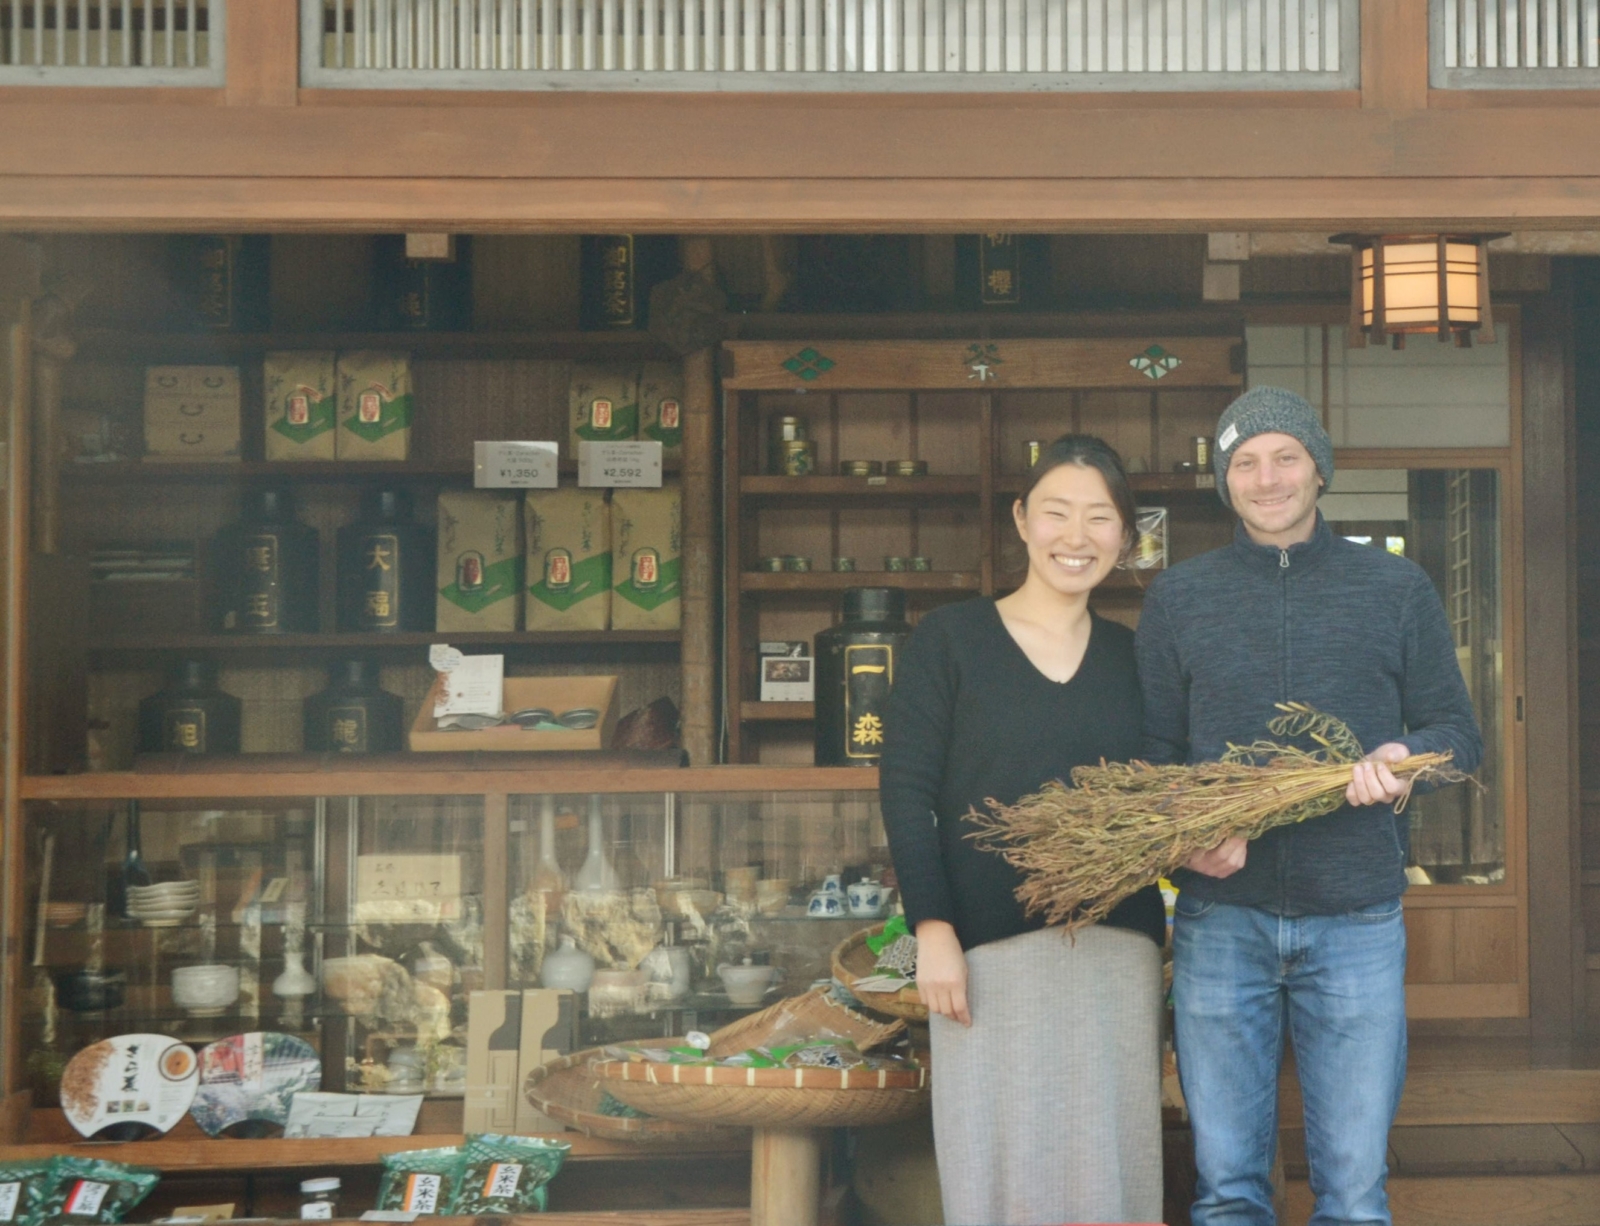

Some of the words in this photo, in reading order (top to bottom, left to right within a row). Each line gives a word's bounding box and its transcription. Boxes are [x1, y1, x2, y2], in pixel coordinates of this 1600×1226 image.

[499, 468, 539, 478] ¥1,350
[603, 468, 642, 477] ¥2,592
[366, 544, 391, 617] 大福
[413, 1176, 436, 1211] 玄米茶
[492, 1164, 516, 1195] 玄米茶
